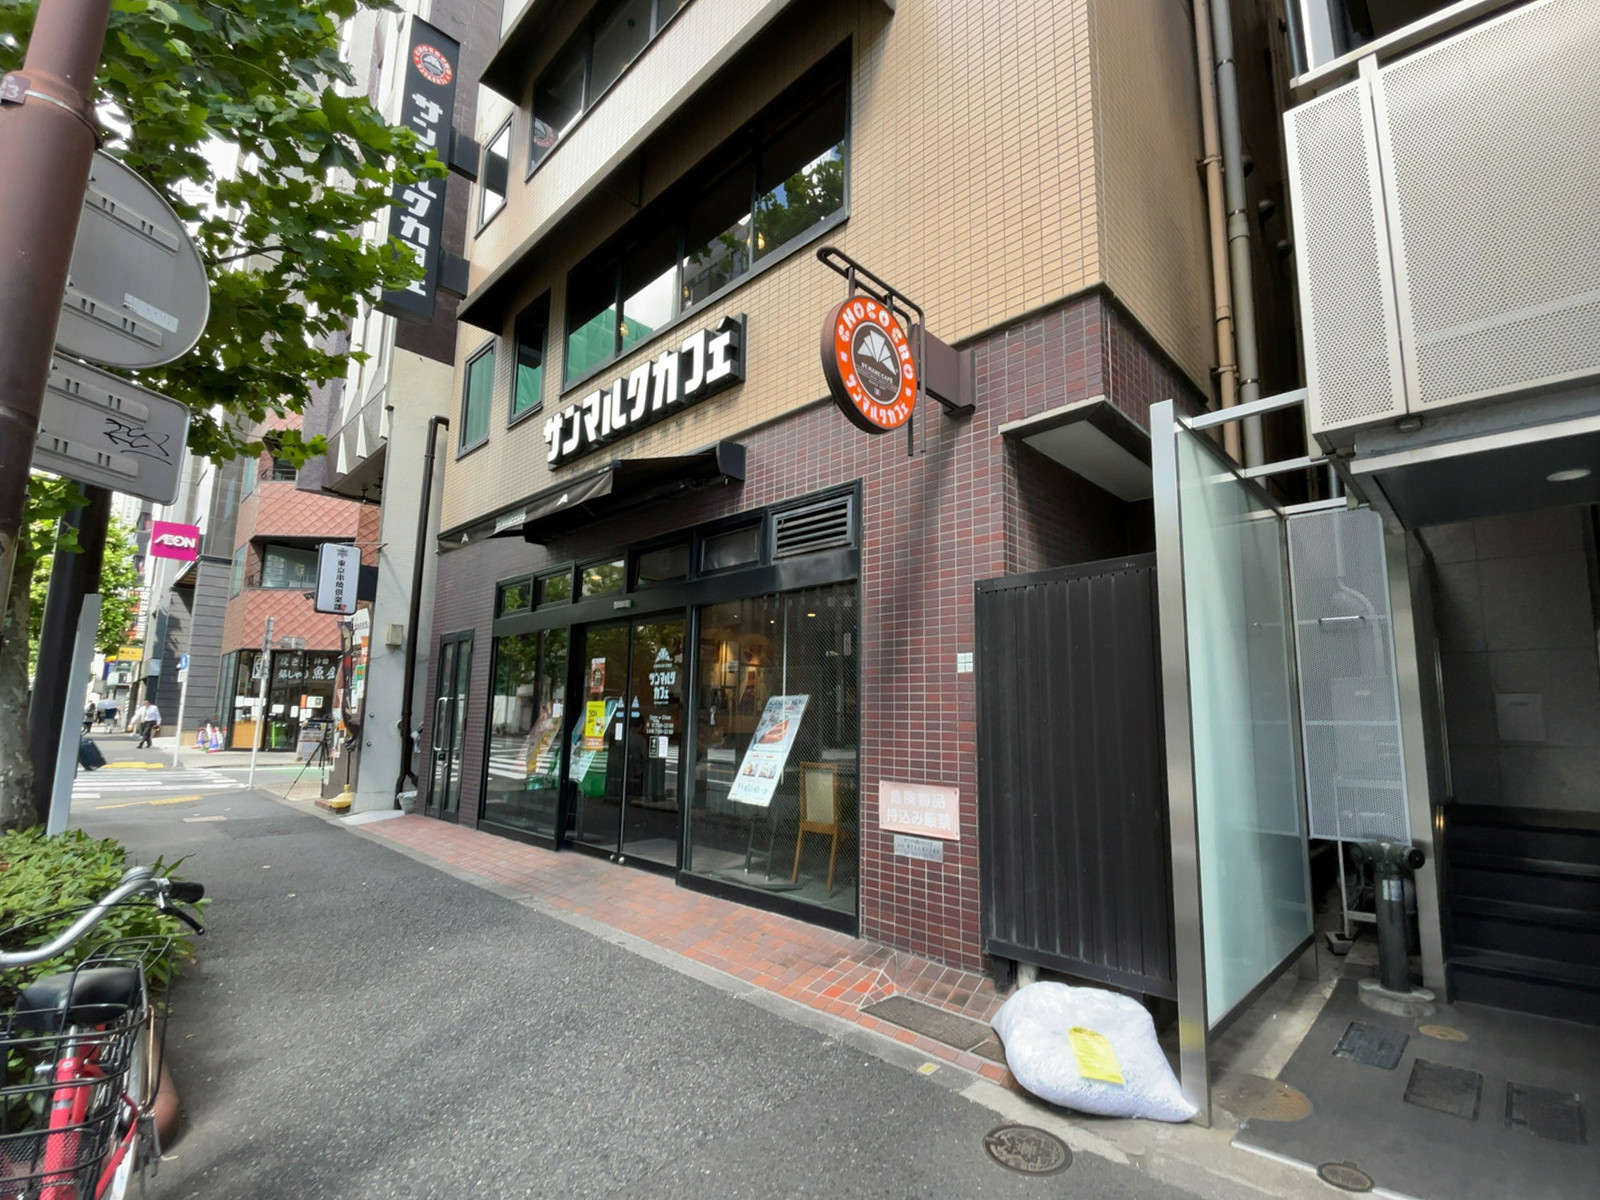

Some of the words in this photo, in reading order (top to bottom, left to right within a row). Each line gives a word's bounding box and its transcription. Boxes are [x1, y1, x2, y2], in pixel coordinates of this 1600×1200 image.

[543, 317, 733, 464] サンマルクカフェ
[845, 372, 910, 425] サンマルクカフェ
